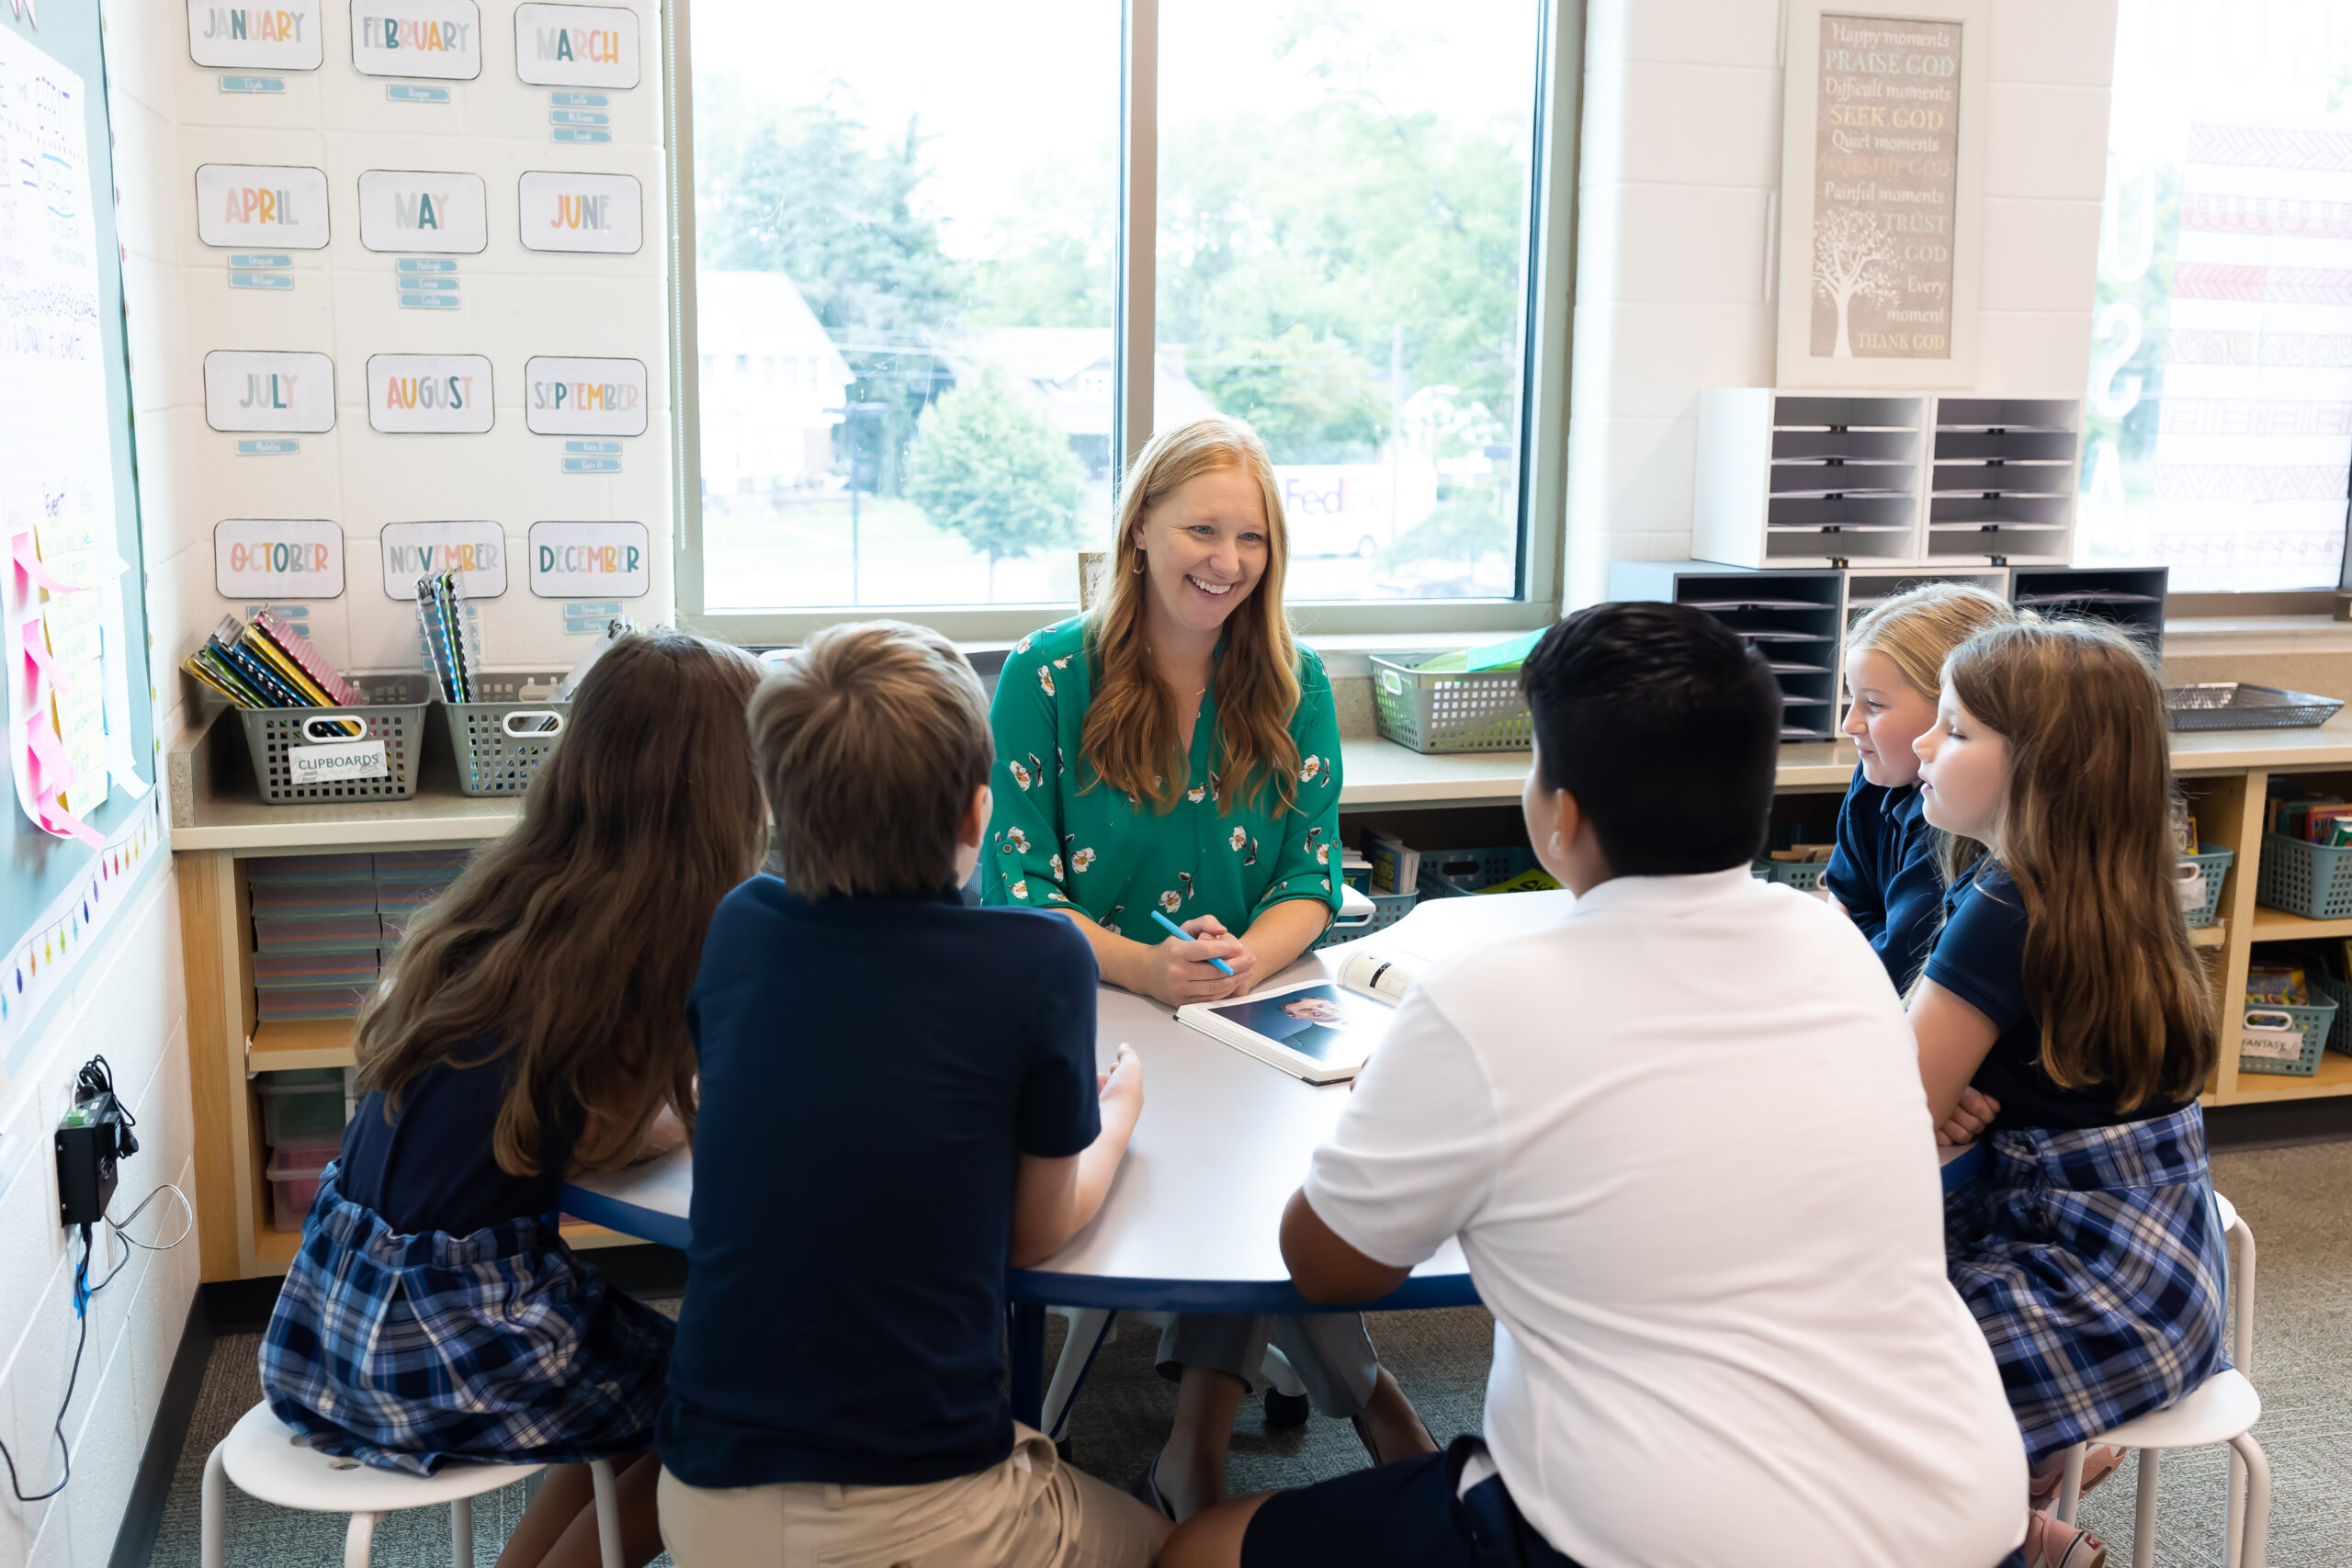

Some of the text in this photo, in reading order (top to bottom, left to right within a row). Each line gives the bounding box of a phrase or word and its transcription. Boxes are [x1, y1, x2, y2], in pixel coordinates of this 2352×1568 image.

[203, 8, 305, 42] JANUARY
[362, 16, 469, 53] FEBRUARY
[1832, 22, 1951, 49] Happy moments
[536, 27, 620, 64] MARCH
[1824, 50, 1955, 77] PRAISE GOD
[1824, 77, 1951, 101] Difficult moments
[1829, 106, 1944, 130] SEEK GOD
[1832, 130, 1940, 153] Quiet moments
[1909, 157, 1950, 177] GOD
[225, 188, 299, 225] APRIL
[1825, 181, 1945, 206] Painful moments
[394, 192, 449, 231] MAY
[550, 194, 611, 231] JUNE
[1883, 213, 1948, 233] TRUST
[1905, 246, 1948, 263] GOD
[1907, 276, 1946, 299] Every
[1886, 304, 1945, 323] moment
[1857, 333, 1945, 350] THANK GOD
[240, 374, 299, 409] JULY
[387, 376, 474, 410] AUGUST
[534, 380, 639, 411] SEPTEMBER
[1284, 478, 1382, 514] FedEx
[231, 542, 329, 573] OCTOBER
[390, 543, 499, 574] NOVEMBER
[540, 545, 639, 574] DECEMBER
[298, 753, 379, 771] CLIPBOARDS
[2242, 1038, 2287, 1051] FANTASY
